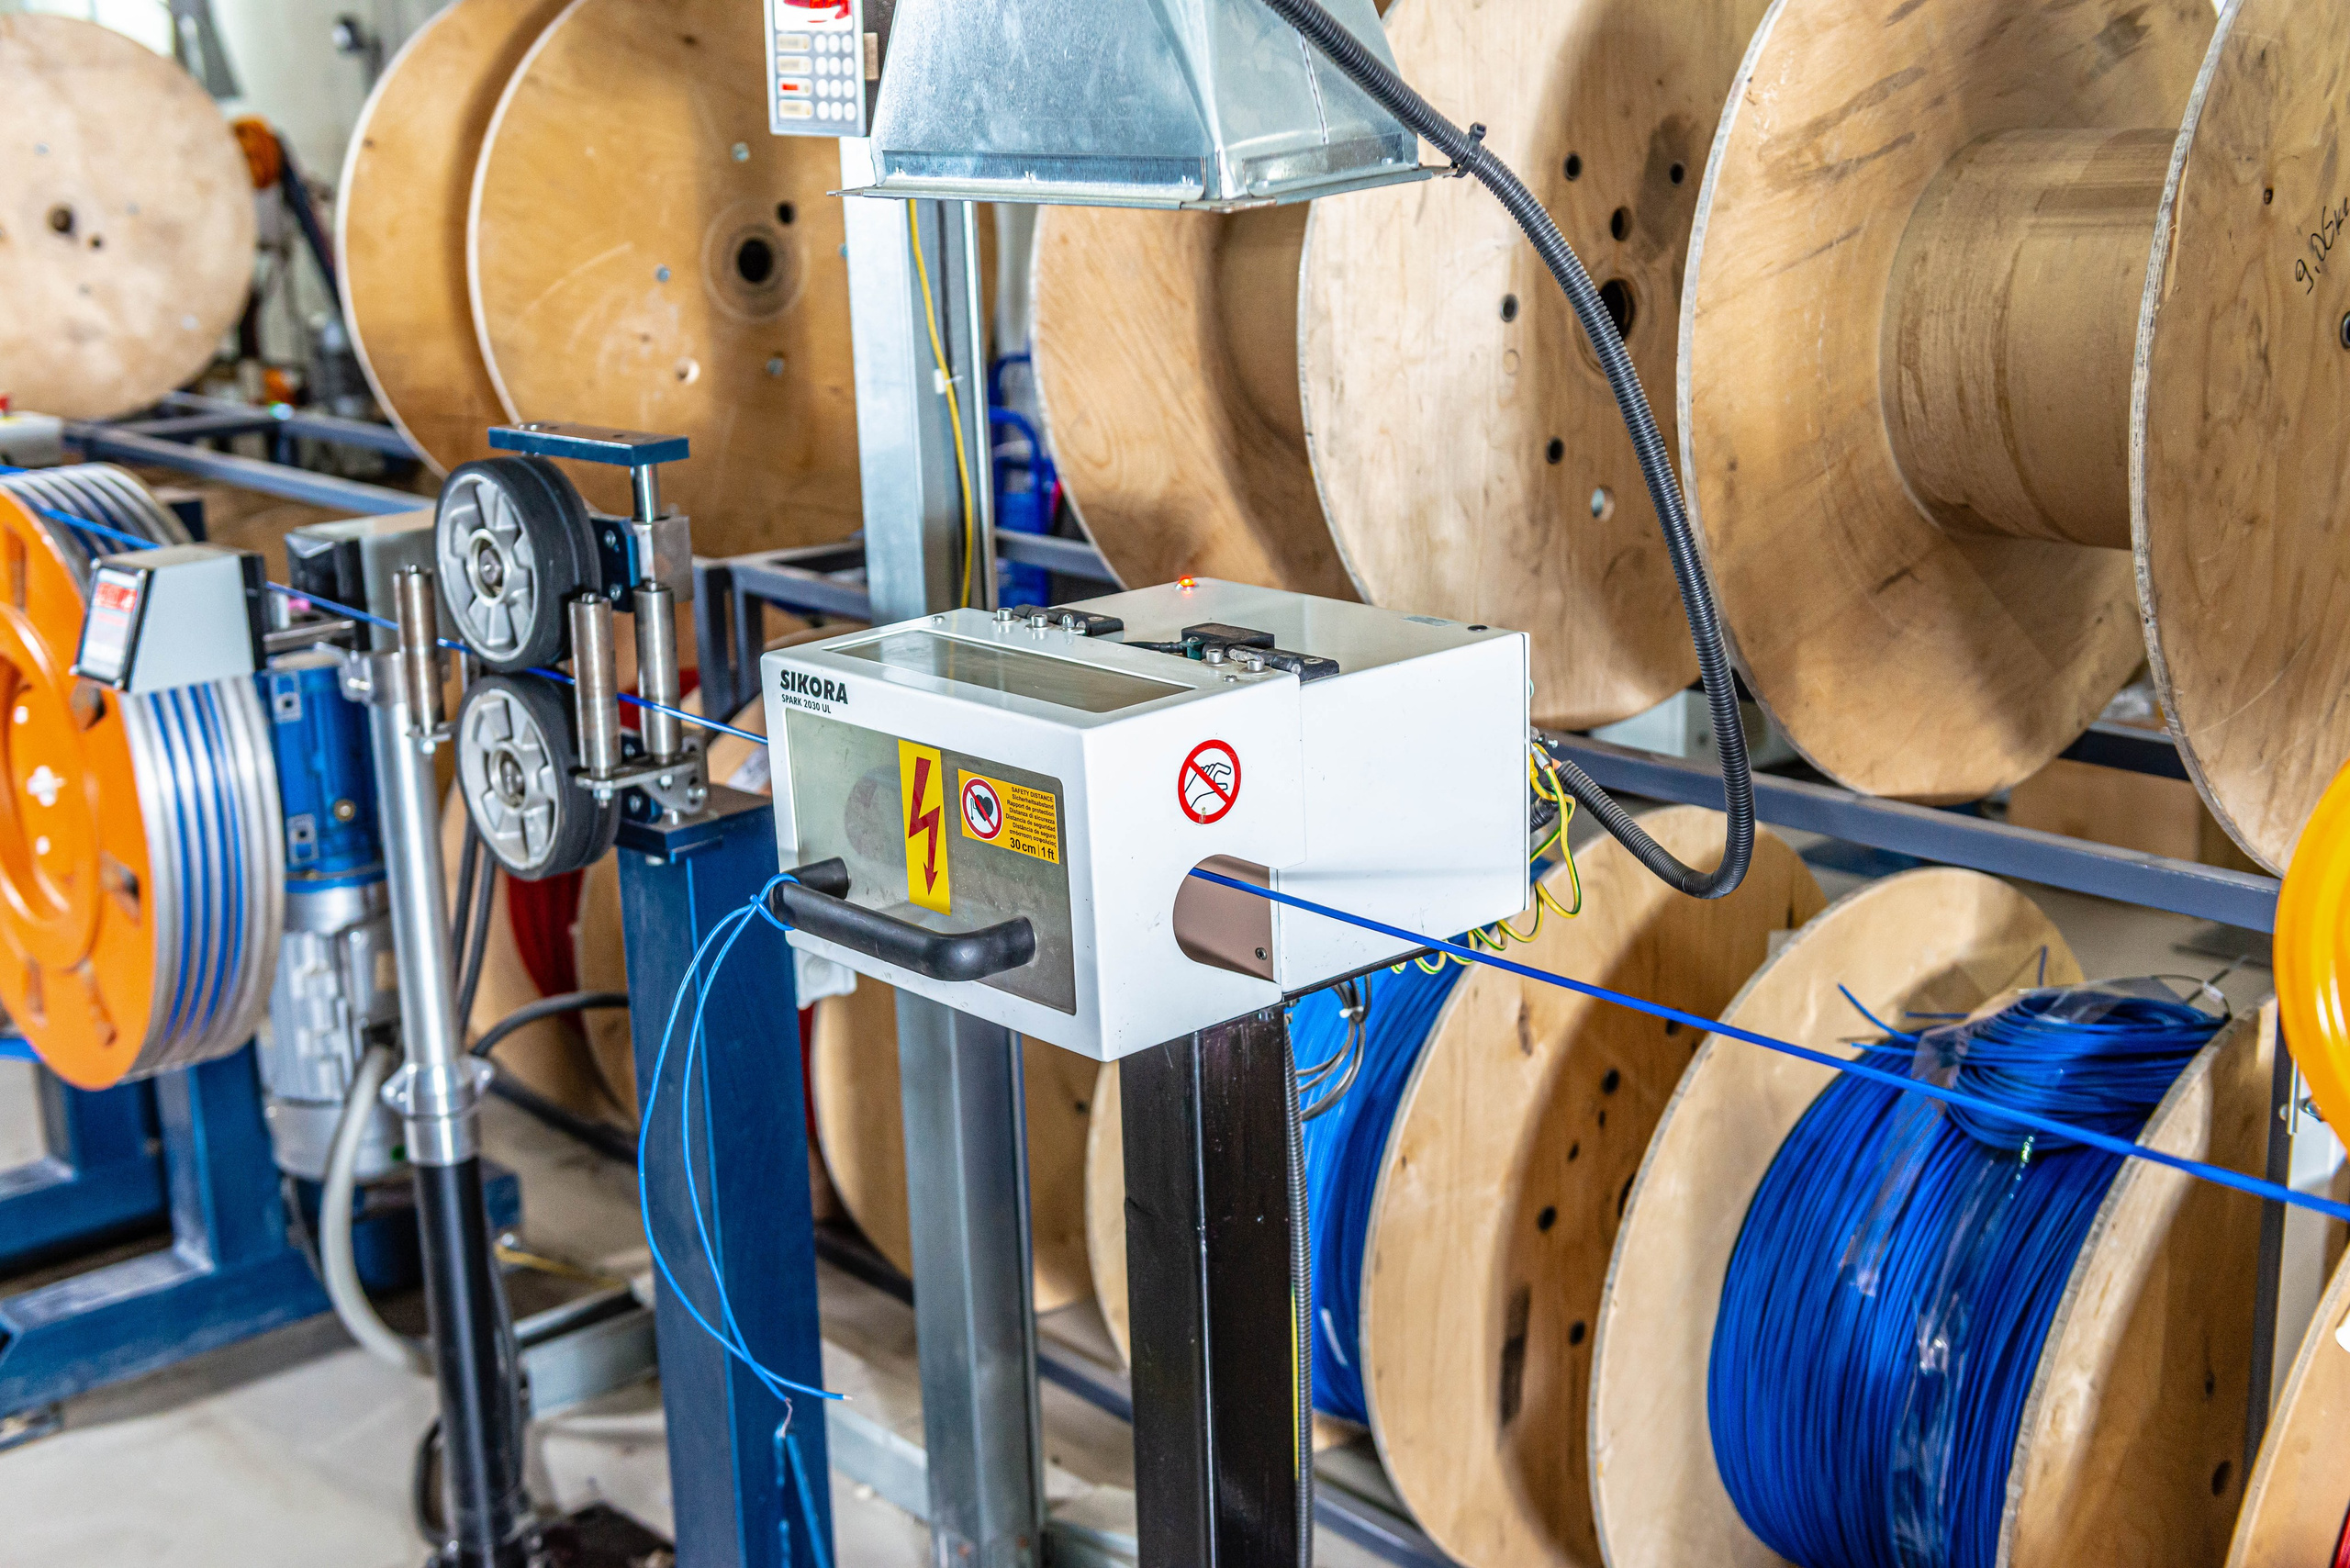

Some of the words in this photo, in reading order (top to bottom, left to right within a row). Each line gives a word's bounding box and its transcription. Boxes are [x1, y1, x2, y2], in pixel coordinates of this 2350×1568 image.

[780, 669, 848, 704] SIKORA
[781, 694, 802, 706] SPARK
[804, 700, 821, 711] 2030
[822, 704, 831, 713] UL
[1012, 787, 1029, 796] SAFETY
[1030, 791, 1053, 802] DISTANCE
[1012, 794, 1054, 810] Sicherheitsabstand
[1007, 800, 1024, 809] Rapport
[1010, 837, 1021, 849] 30
[1022, 844, 1035, 855] cm
[1041, 846, 1046, 857] 1
[1047, 848, 1055, 860] ft
